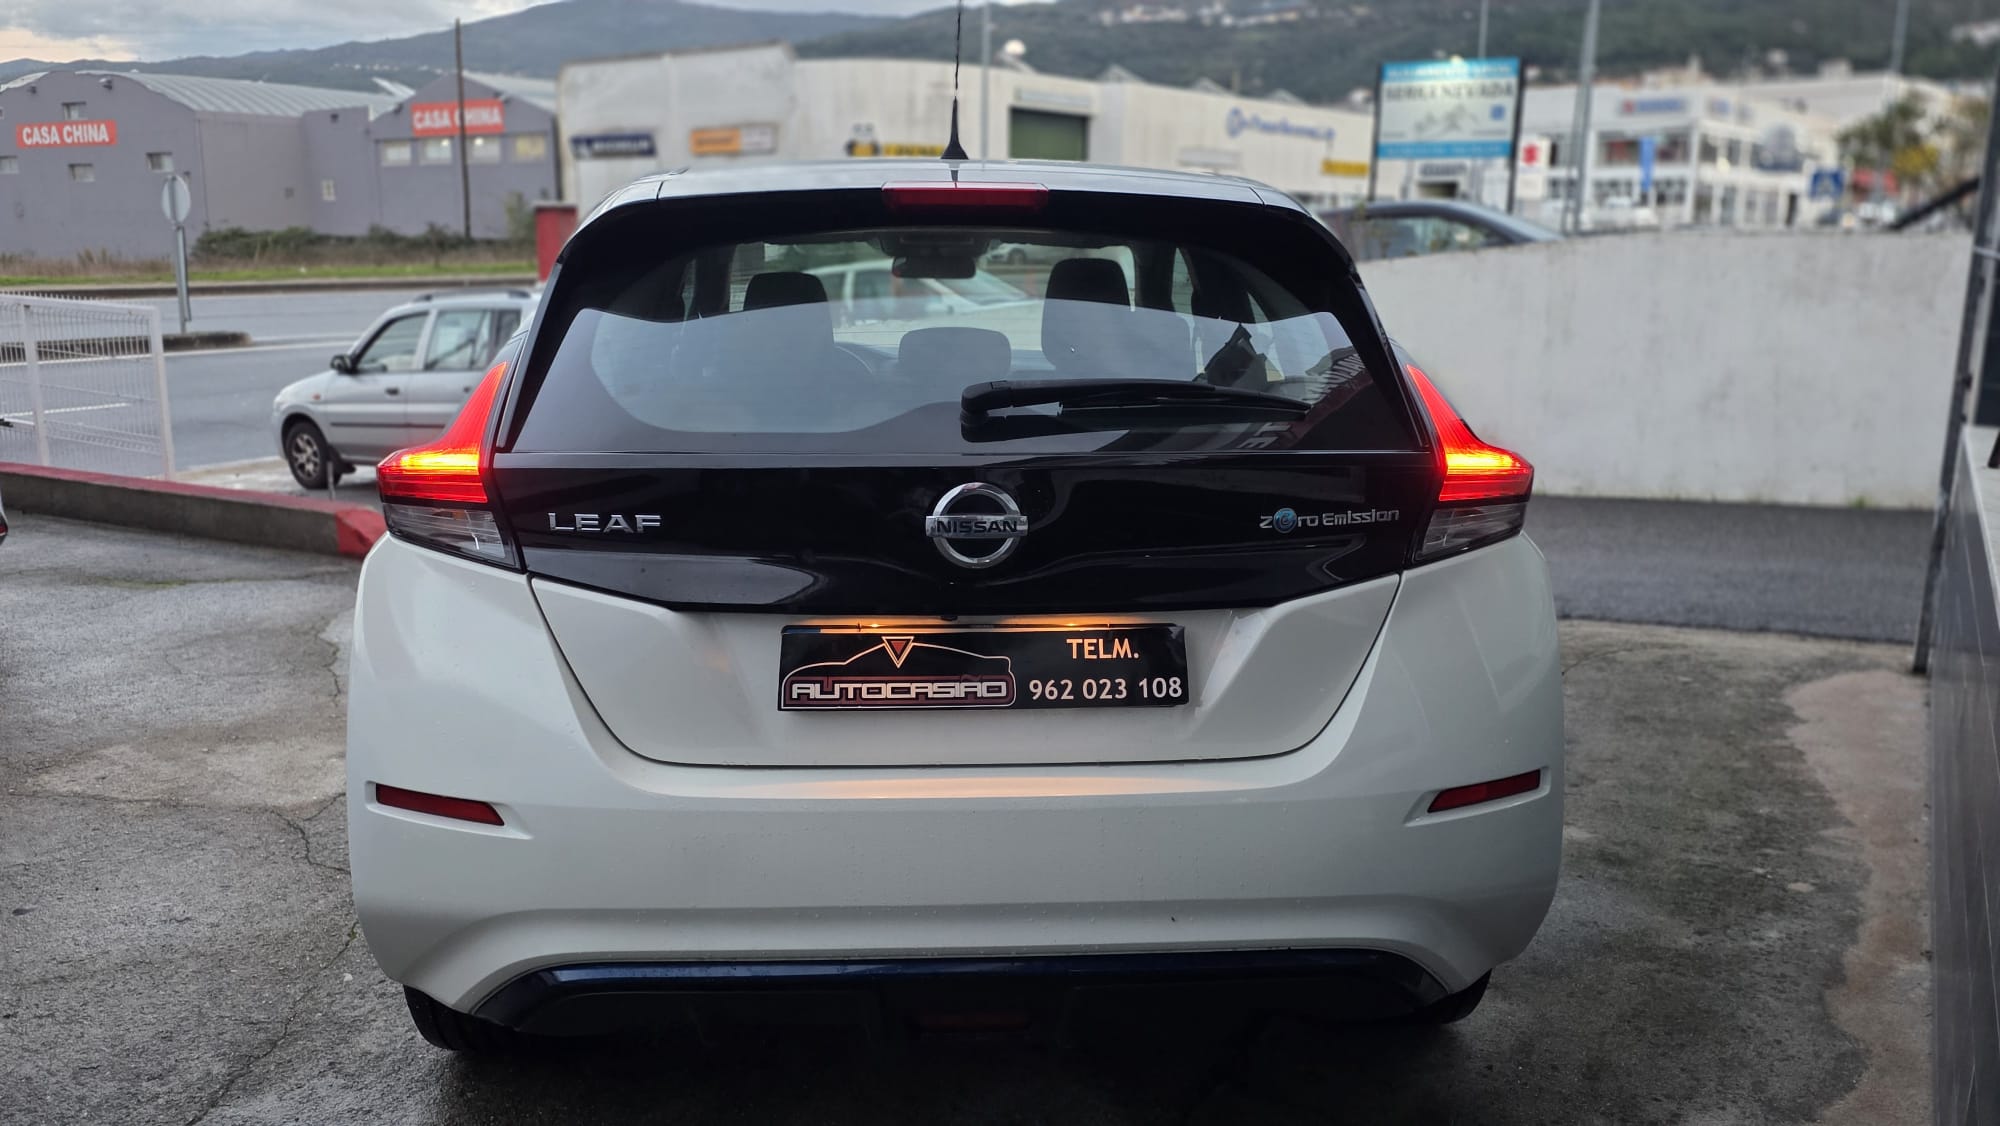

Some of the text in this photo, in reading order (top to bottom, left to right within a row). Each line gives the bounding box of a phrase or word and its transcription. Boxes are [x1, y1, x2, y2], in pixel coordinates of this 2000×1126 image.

[414, 109, 451, 129] CASA
[22, 122, 110, 145] CASA CHINA
[547, 512, 662, 534] LEAF
[936, 520, 1018, 533] NISSAN
[1322, 508, 1400, 527] Emission
[1066, 638, 1140, 659] TELM.
[1028, 676, 1183, 700] 962 023 108
